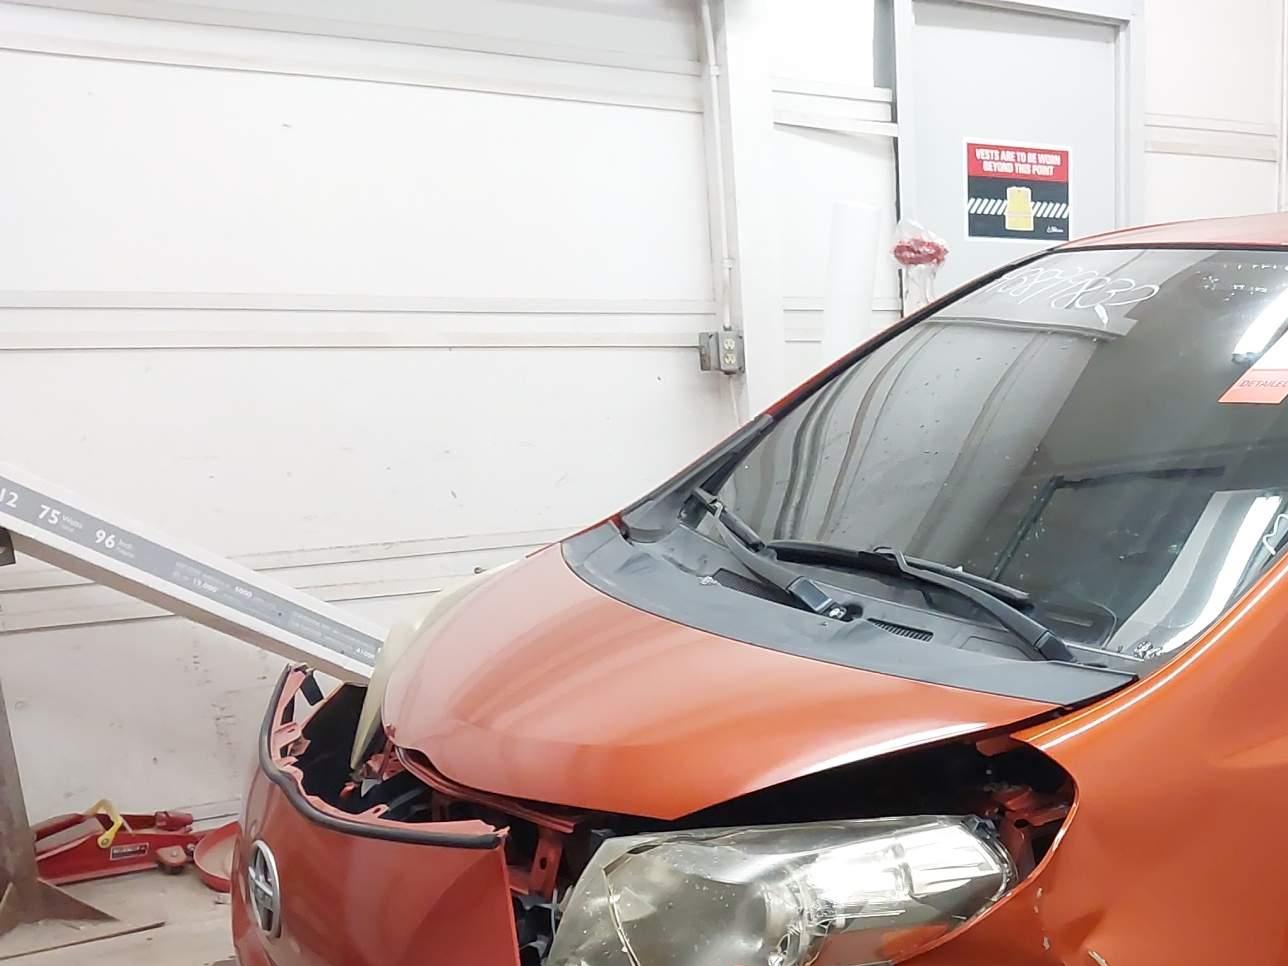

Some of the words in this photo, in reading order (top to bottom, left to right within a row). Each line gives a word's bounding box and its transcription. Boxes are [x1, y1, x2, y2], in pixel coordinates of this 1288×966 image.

[1000, 150, 1016, 162] ARE
[1016, 151, 1027, 163] TO
[1027, 152, 1038, 164] BE
[1014, 163, 1032, 175] THIS
[1032, 164, 1054, 176] POINT
[38, 504, 61, 524] 75
[95, 528, 116, 549] 96
